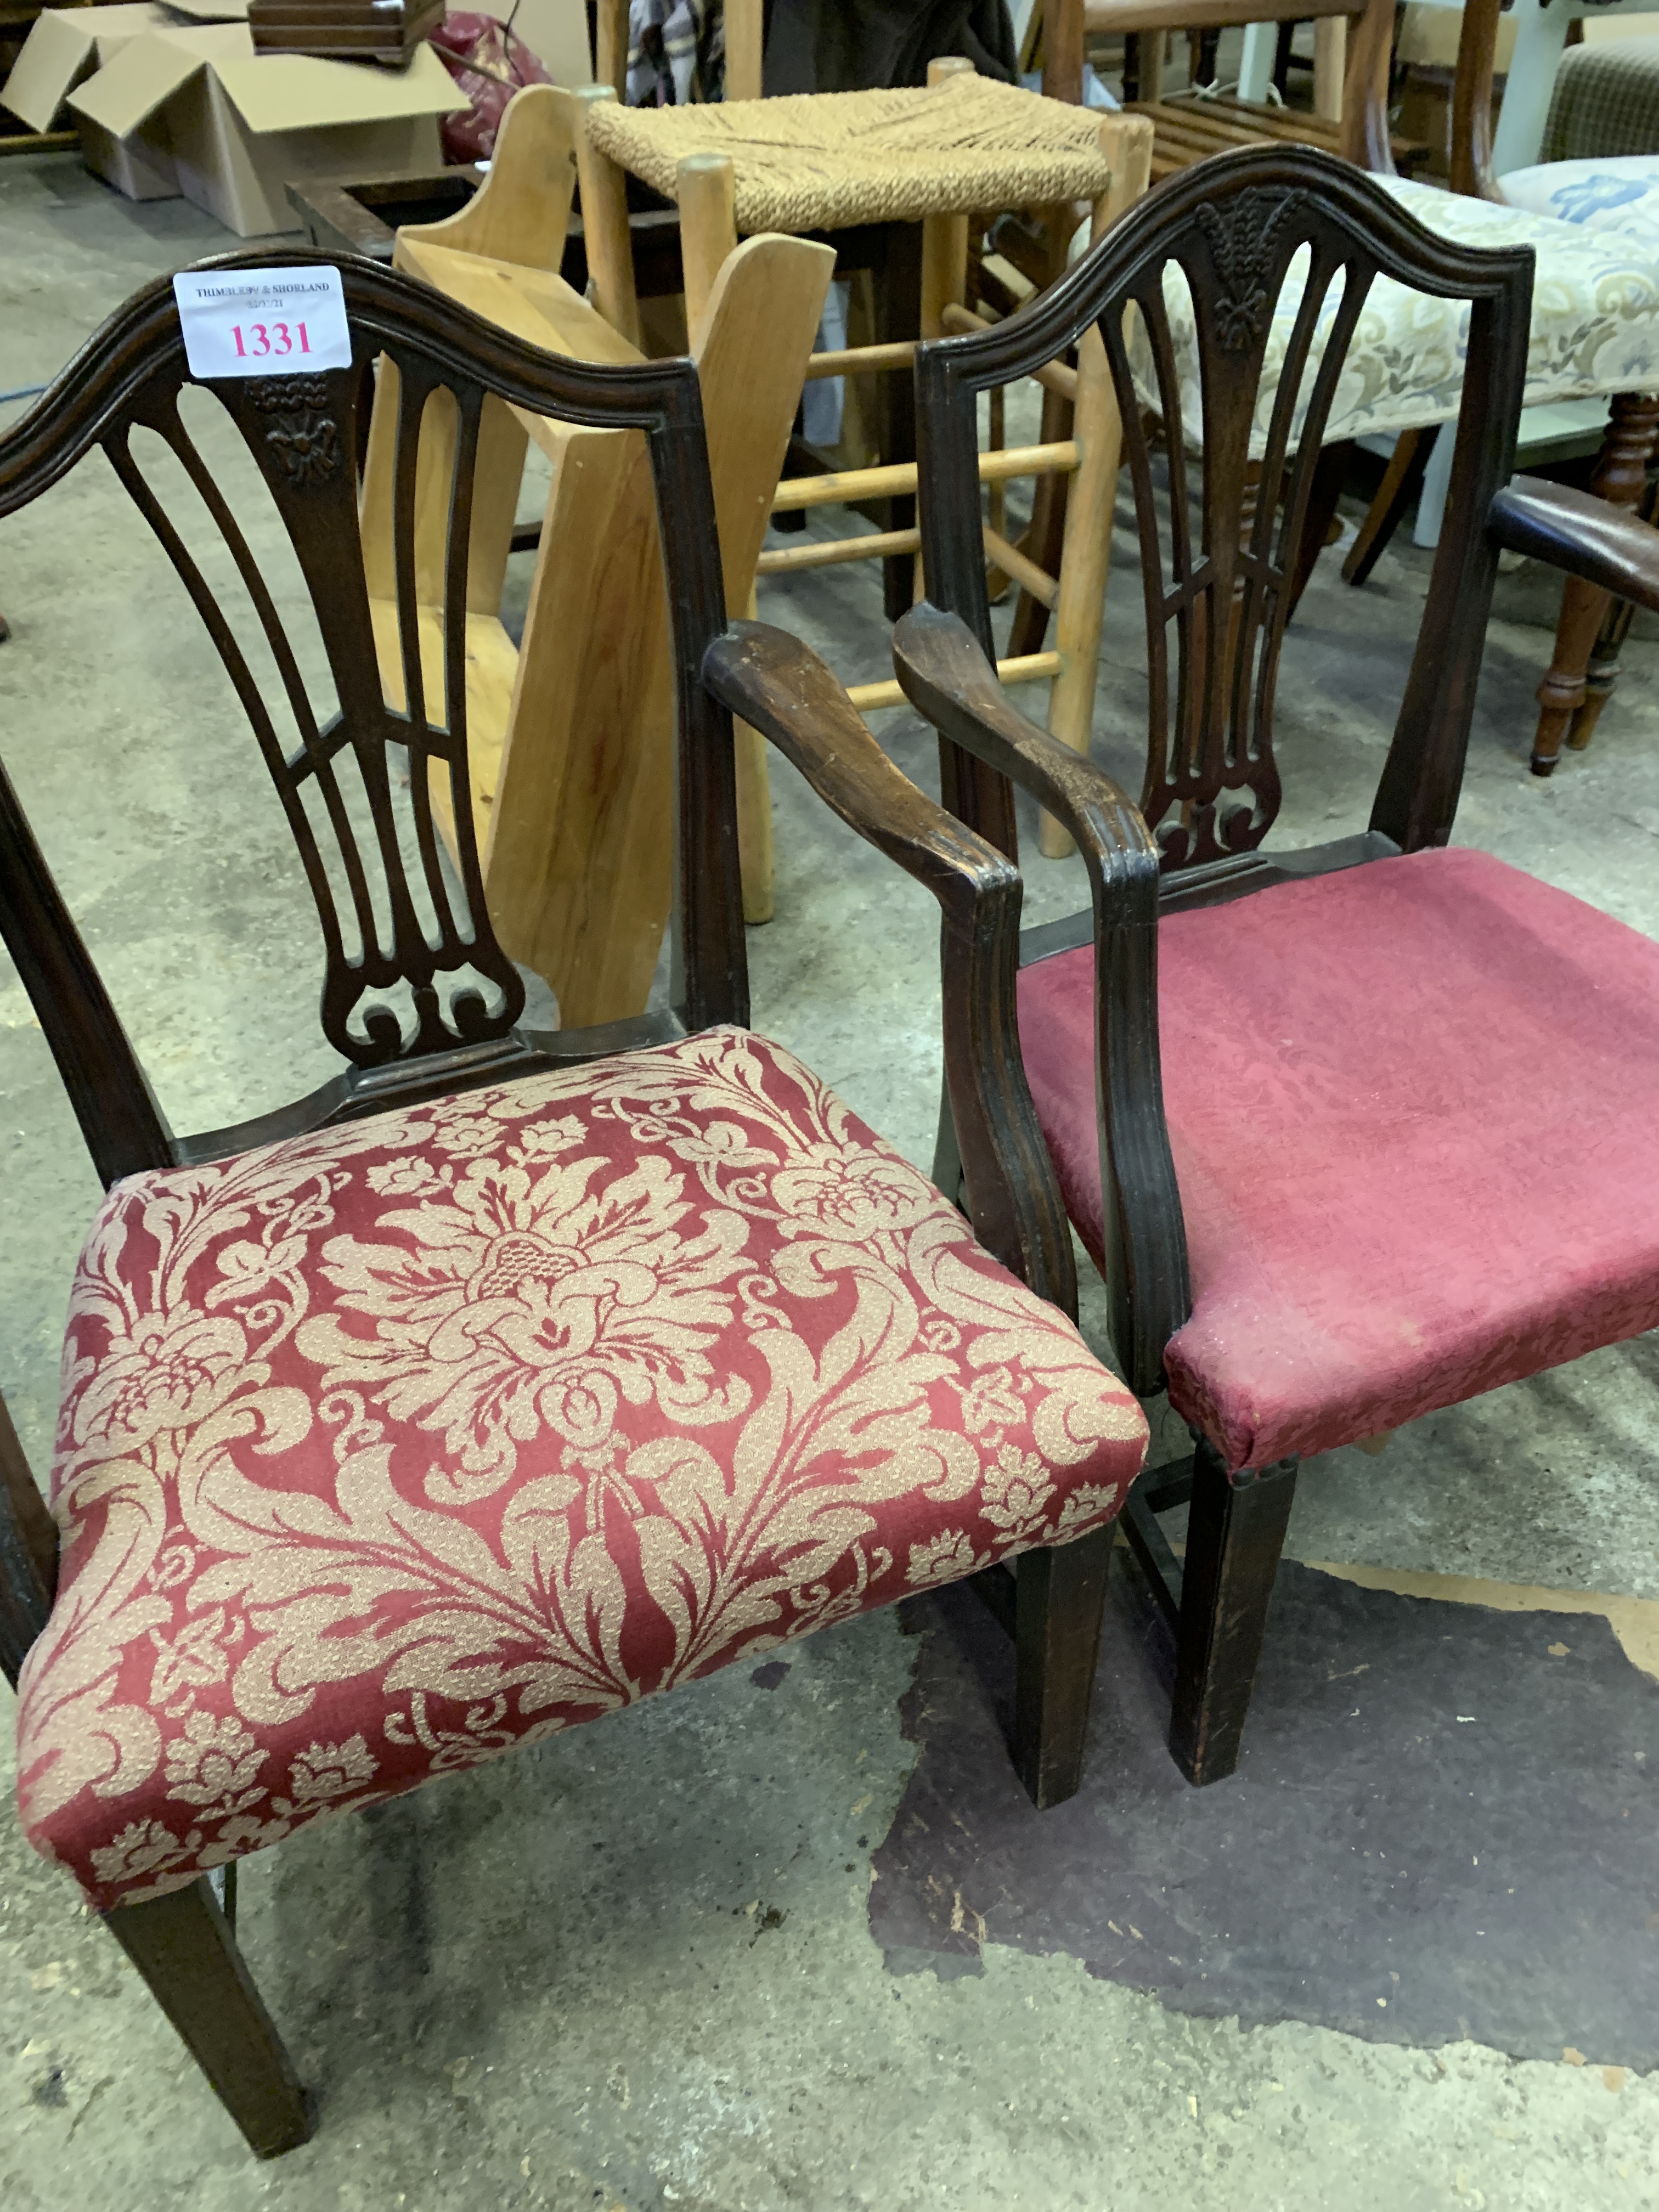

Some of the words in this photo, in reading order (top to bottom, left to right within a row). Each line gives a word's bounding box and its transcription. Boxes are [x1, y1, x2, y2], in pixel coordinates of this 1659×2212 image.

[262, 285, 270, 294] &
[273, 283, 329, 293] SHORLAND
[229, 321, 314, 357] 1331
